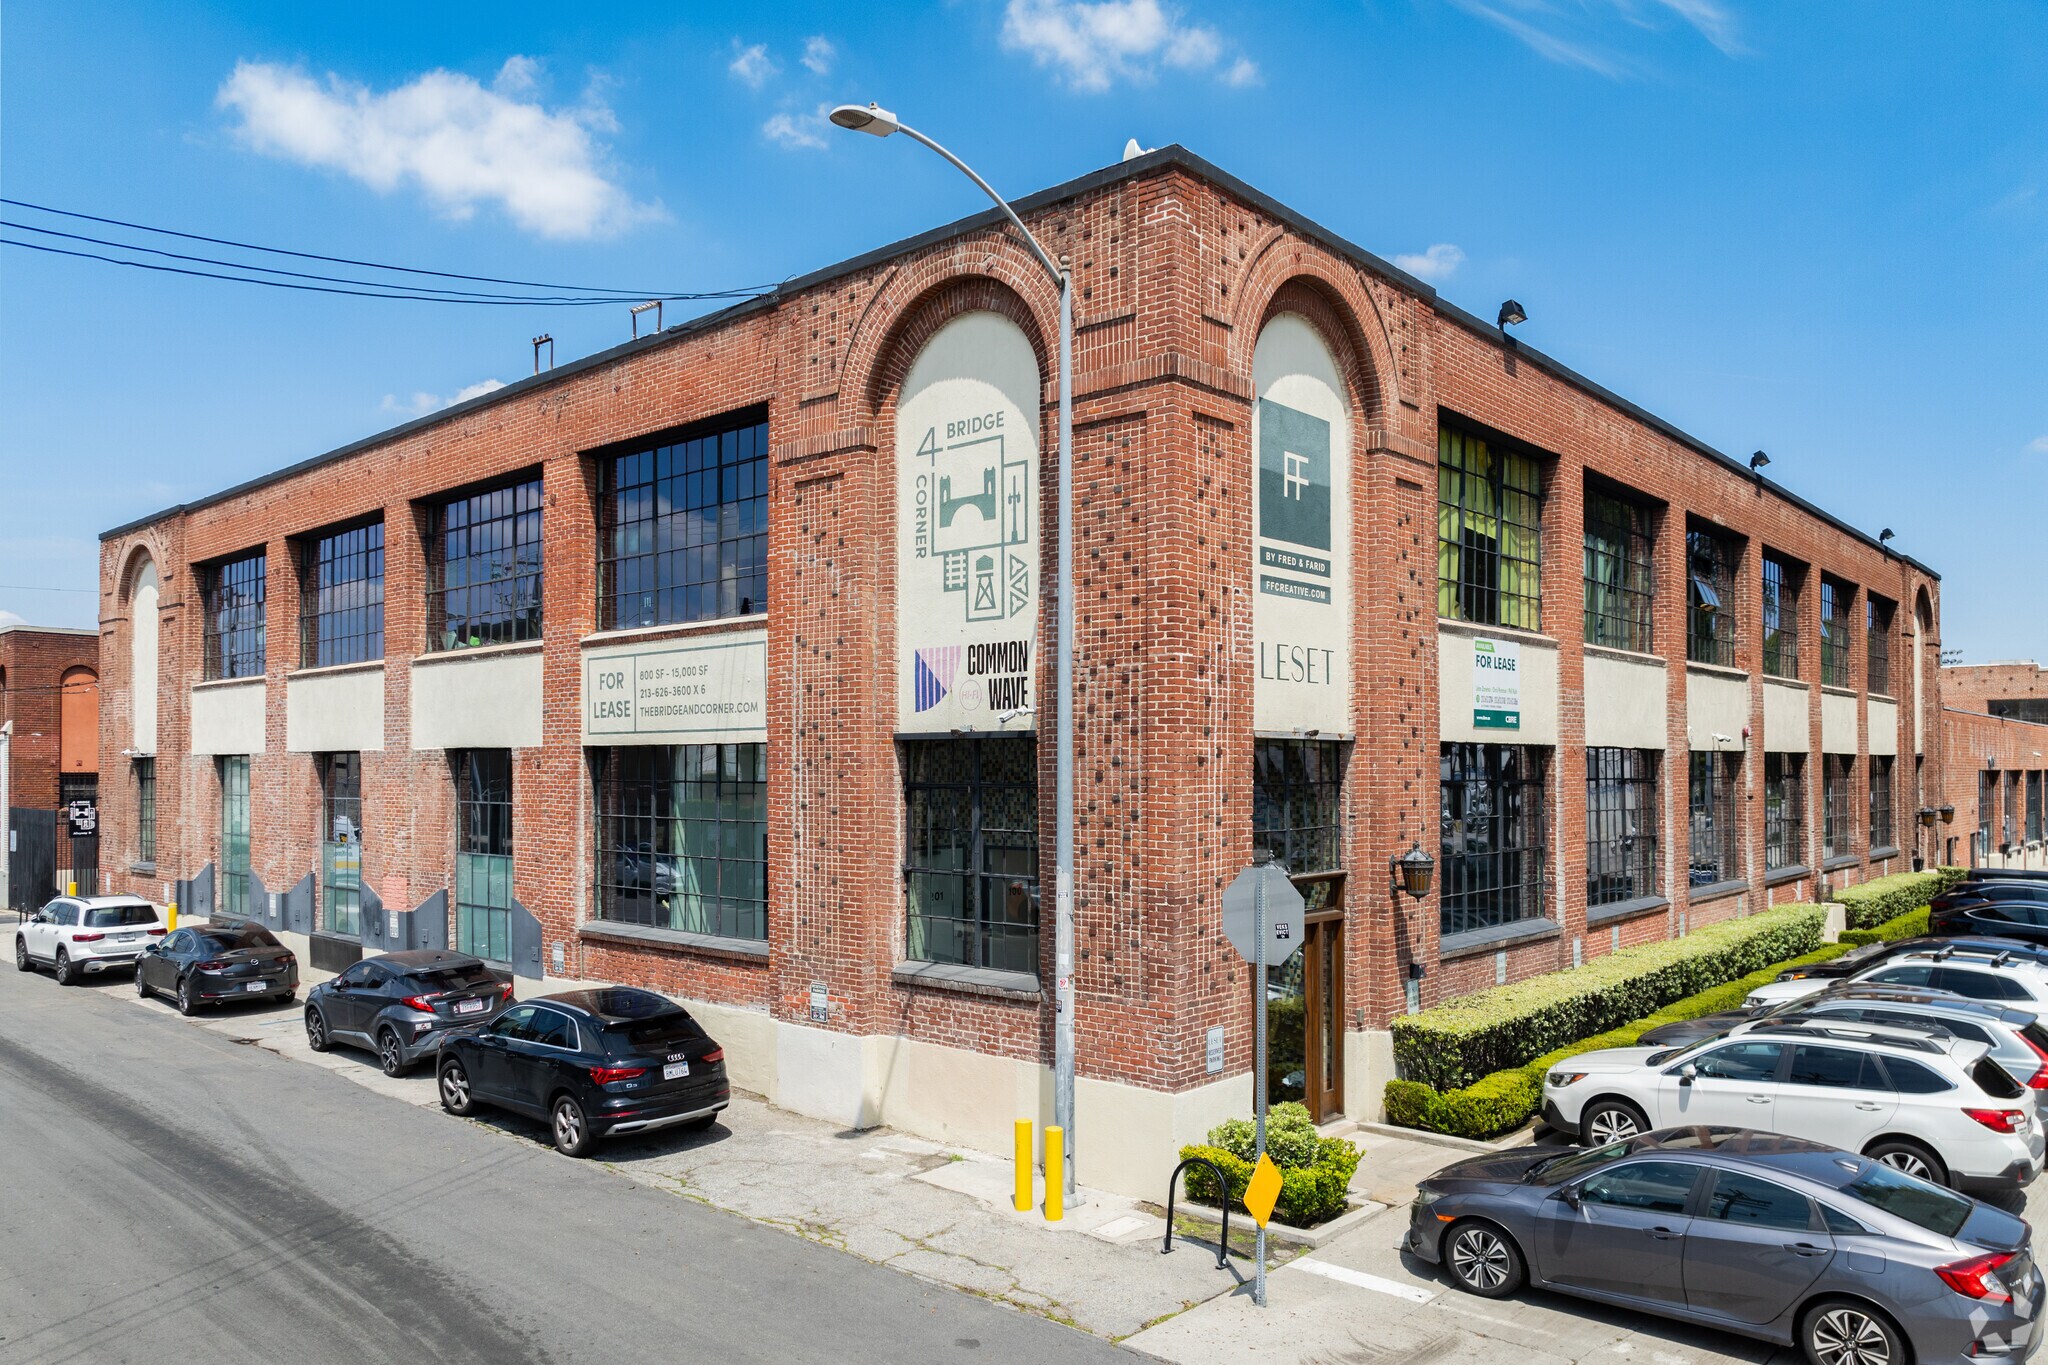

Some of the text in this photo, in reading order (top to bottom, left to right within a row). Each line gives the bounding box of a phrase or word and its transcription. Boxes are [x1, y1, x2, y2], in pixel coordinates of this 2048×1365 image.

[916, 411, 1005, 467] 4 BRIDGE
[916, 474, 927, 559] CORNER
[1265, 551, 1326, 572] BY FRED & FARID
[1266, 580, 1326, 600] FFCREATIVE.COM
[967, 640, 1028, 675] COMMON
[1260, 642, 1334, 685] LESET
[1475, 655, 1516, 671] FOR LEASE
[599, 671, 624, 690] FOR
[639, 670, 654, 681] 800
[655, 668, 665, 679] SF
[672, 666, 697, 679] 15,000
[699, 665, 708, 676] SF
[640, 684, 706, 699] 213-626-3600 X 6
[988, 677, 1028, 710] WAVE
[593, 700, 631, 719] LEASE
[640, 702, 759, 717] THEBRIDGEANDCORNER.COM
[1008, 887, 1022, 896] 100
